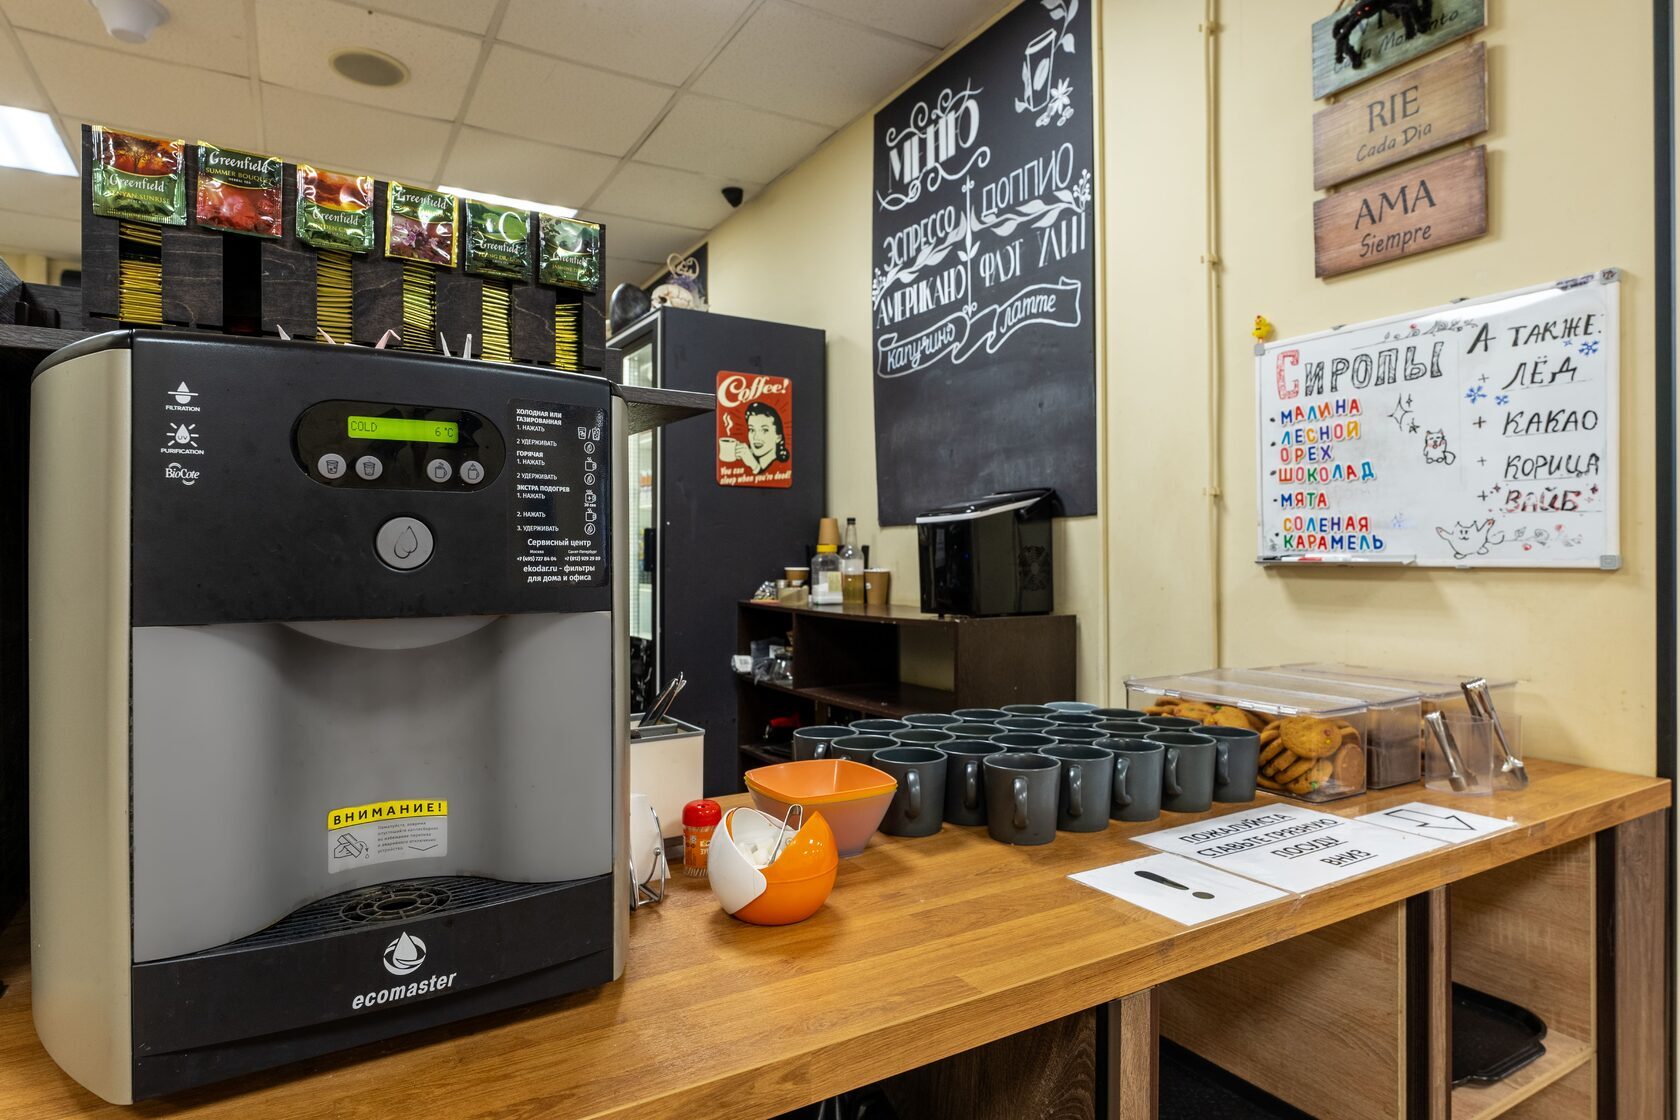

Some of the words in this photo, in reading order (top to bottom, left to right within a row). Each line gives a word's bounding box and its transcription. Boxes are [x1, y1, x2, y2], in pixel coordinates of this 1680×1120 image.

[1367, 85, 1421, 134] RIE
[1355, 134, 1397, 164] Cada
[1402, 122, 1433, 148] Dia
[205, 167, 236, 178] SUMMER
[209, 151, 269, 174] Greenfield
[110, 173, 165, 193] Greenfield
[982, 142, 1074, 217] ДОППИО
[397, 189, 448, 210] Greenfield
[1354, 179, 1438, 230] AMA
[312, 208, 359, 226] Greenfield
[883, 205, 956, 271] ЭСПРЕССО
[1359, 223, 1433, 259] Siempre
[876, 264, 967, 330] АМЕРИКАНО
[1000, 294, 1057, 333] латте
[887, 322, 956, 372] капучино
[1466, 322, 1497, 355] А
[1502, 355, 1578, 391] ЛЁД
[717, 375, 790, 408] Coffee!
[165, 404, 201, 412] FILTRATION
[516, 408, 549, 418] ХОЛОДНАЯ
[1281, 398, 1361, 425] МАЛИНА
[350, 420, 378, 433] COLD
[434, 426, 442, 437] 6
[516, 416, 562, 426] ГАЗИРОВАННАЯ
[1281, 420, 1360, 445] ЛЕСНОЙ
[1502, 409, 1599, 436] КАКАО
[516, 450, 544, 458] ГОРЯЧАЯ
[521, 439, 557, 447] УДЕРЖИВАТЬ
[1280, 445, 1333, 463] ОРЕХ
[165, 467, 200, 479] BioCote
[1278, 461, 1375, 483] ШОКОЛАД
[1504, 453, 1600, 480] КОРИЦА
[539, 485, 570, 493] ПОДОГРЕВ
[1280, 492, 1328, 508] МЯТА
[1283, 516, 1370, 533] СОЛЕНАЯ
[527, 538, 569, 548] Сервисный
[570, 540, 592, 548] центр
[1283, 534, 1384, 550] КАРАМЕЛЬ
[523, 564, 558, 572] ekodar.ru
[563, 564, 596, 573] фильтры
[527, 575, 542, 583] для
[569, 573, 592, 582] офиса
[333, 802, 442, 826] ВНИМАНИЕ!
[1179, 813, 1293, 844] ПОЖАЛУЙСТА
[1197, 835, 1271, 857] СТАВЬТЕ
[1264, 818, 1338, 840] ГРЯЗНУЮ
[1270, 835, 1341, 858] ПОСУДУ
[1320, 849, 1372, 866] ВНИЗ
[352, 972, 458, 1010] ecomaster
